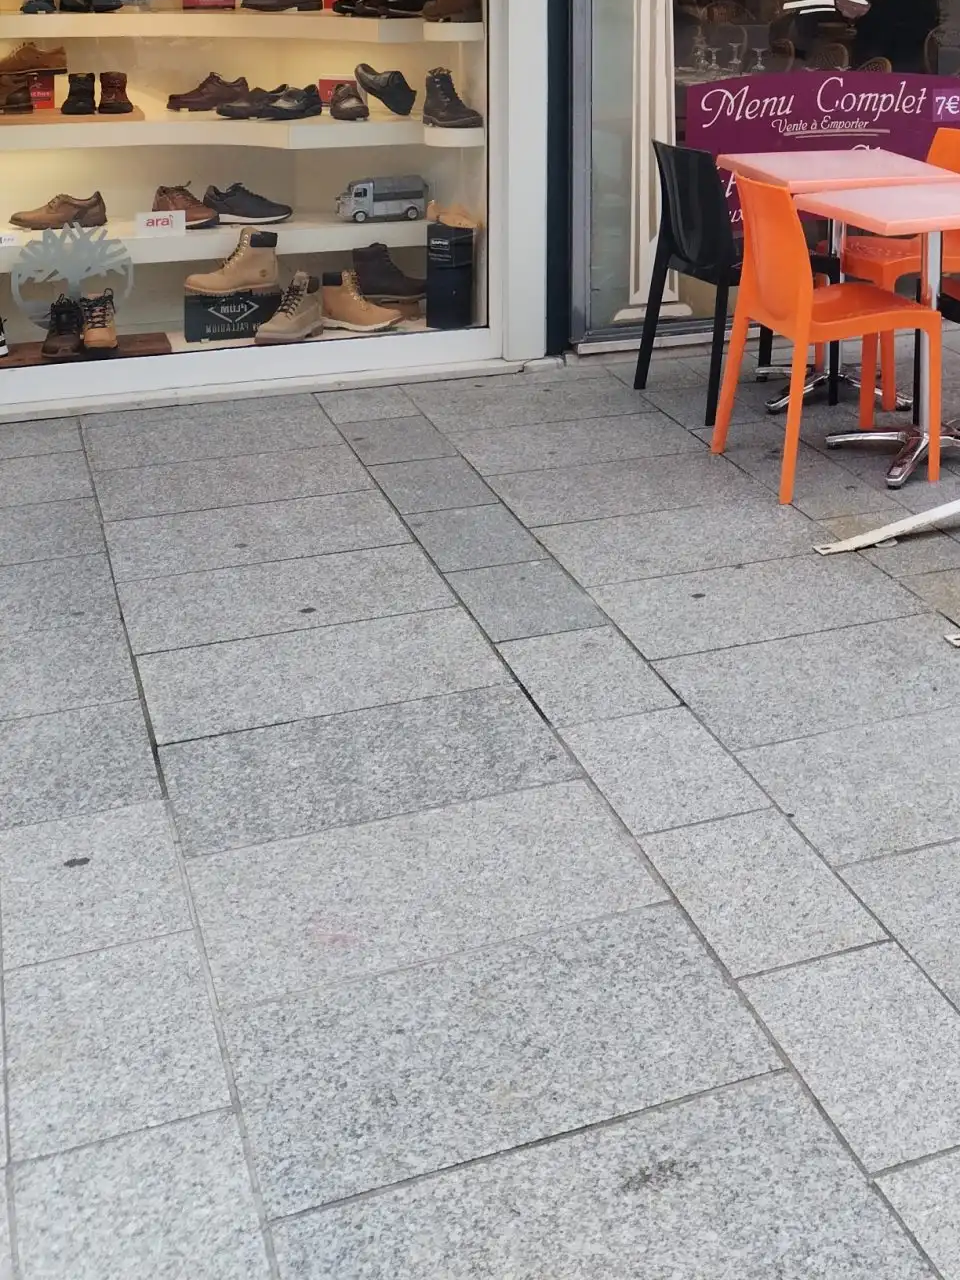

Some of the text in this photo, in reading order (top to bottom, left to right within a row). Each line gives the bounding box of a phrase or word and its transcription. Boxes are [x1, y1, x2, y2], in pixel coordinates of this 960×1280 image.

[701, 77, 960, 128] Menu Complet 7€
[771, 115, 871, 134] Vente à Emporter
[145, 215, 172, 229] ara
